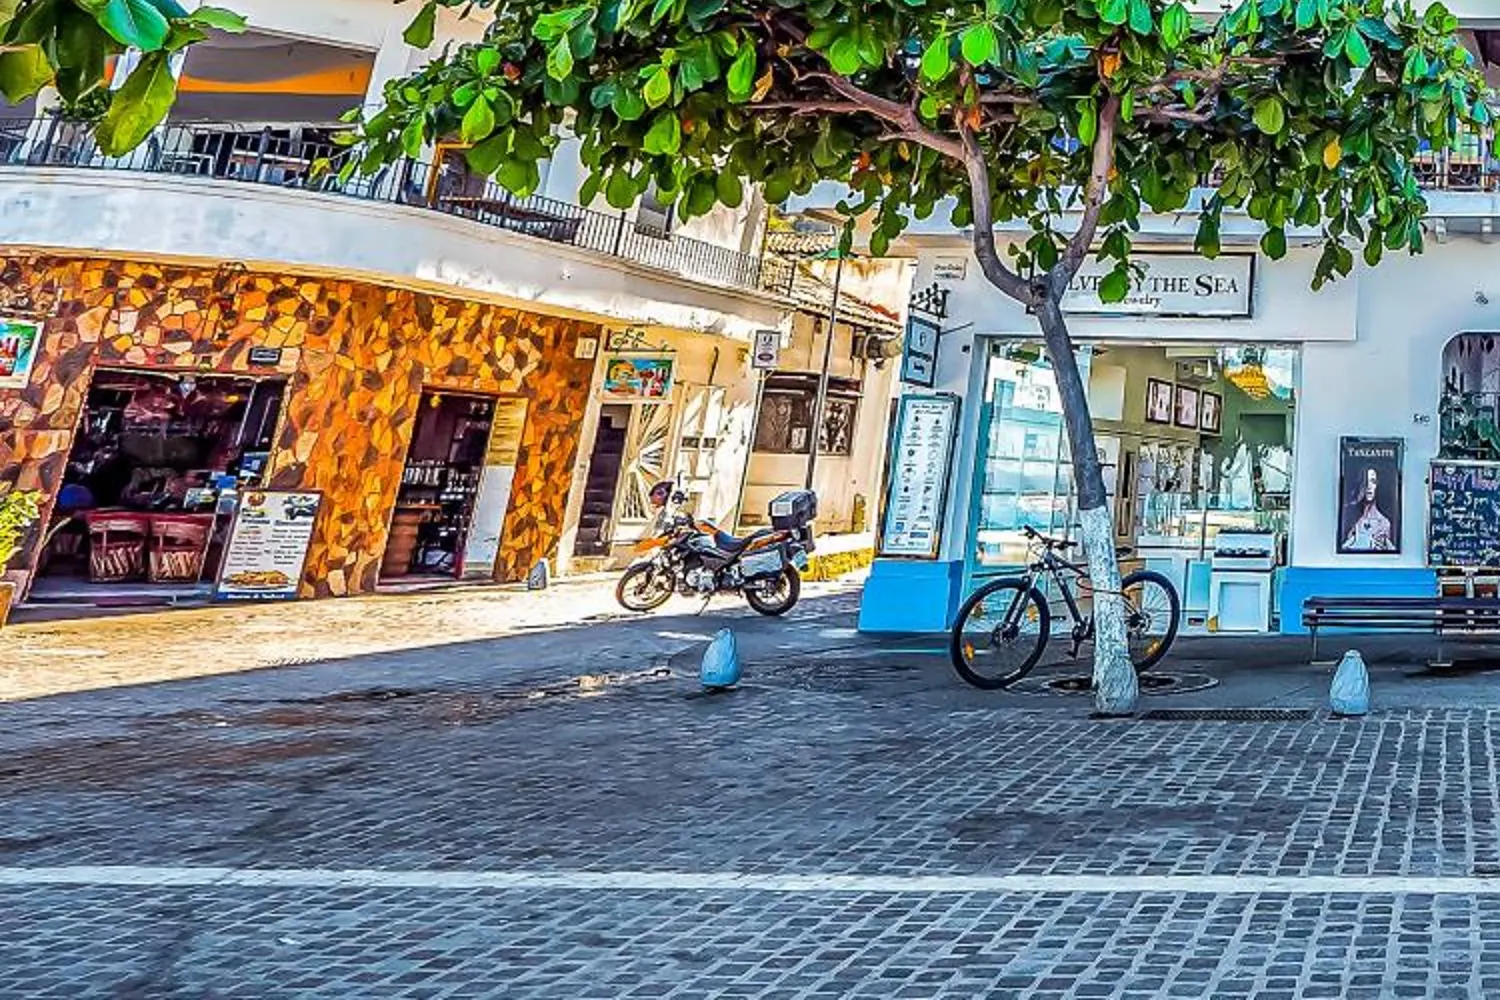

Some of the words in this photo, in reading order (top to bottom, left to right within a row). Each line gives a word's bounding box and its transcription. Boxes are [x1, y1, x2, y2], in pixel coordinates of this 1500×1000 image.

[1151, 277, 1190, 293] THE
[1193, 272, 1239, 297] SEA
[1123, 293, 1162, 308] ewelry
